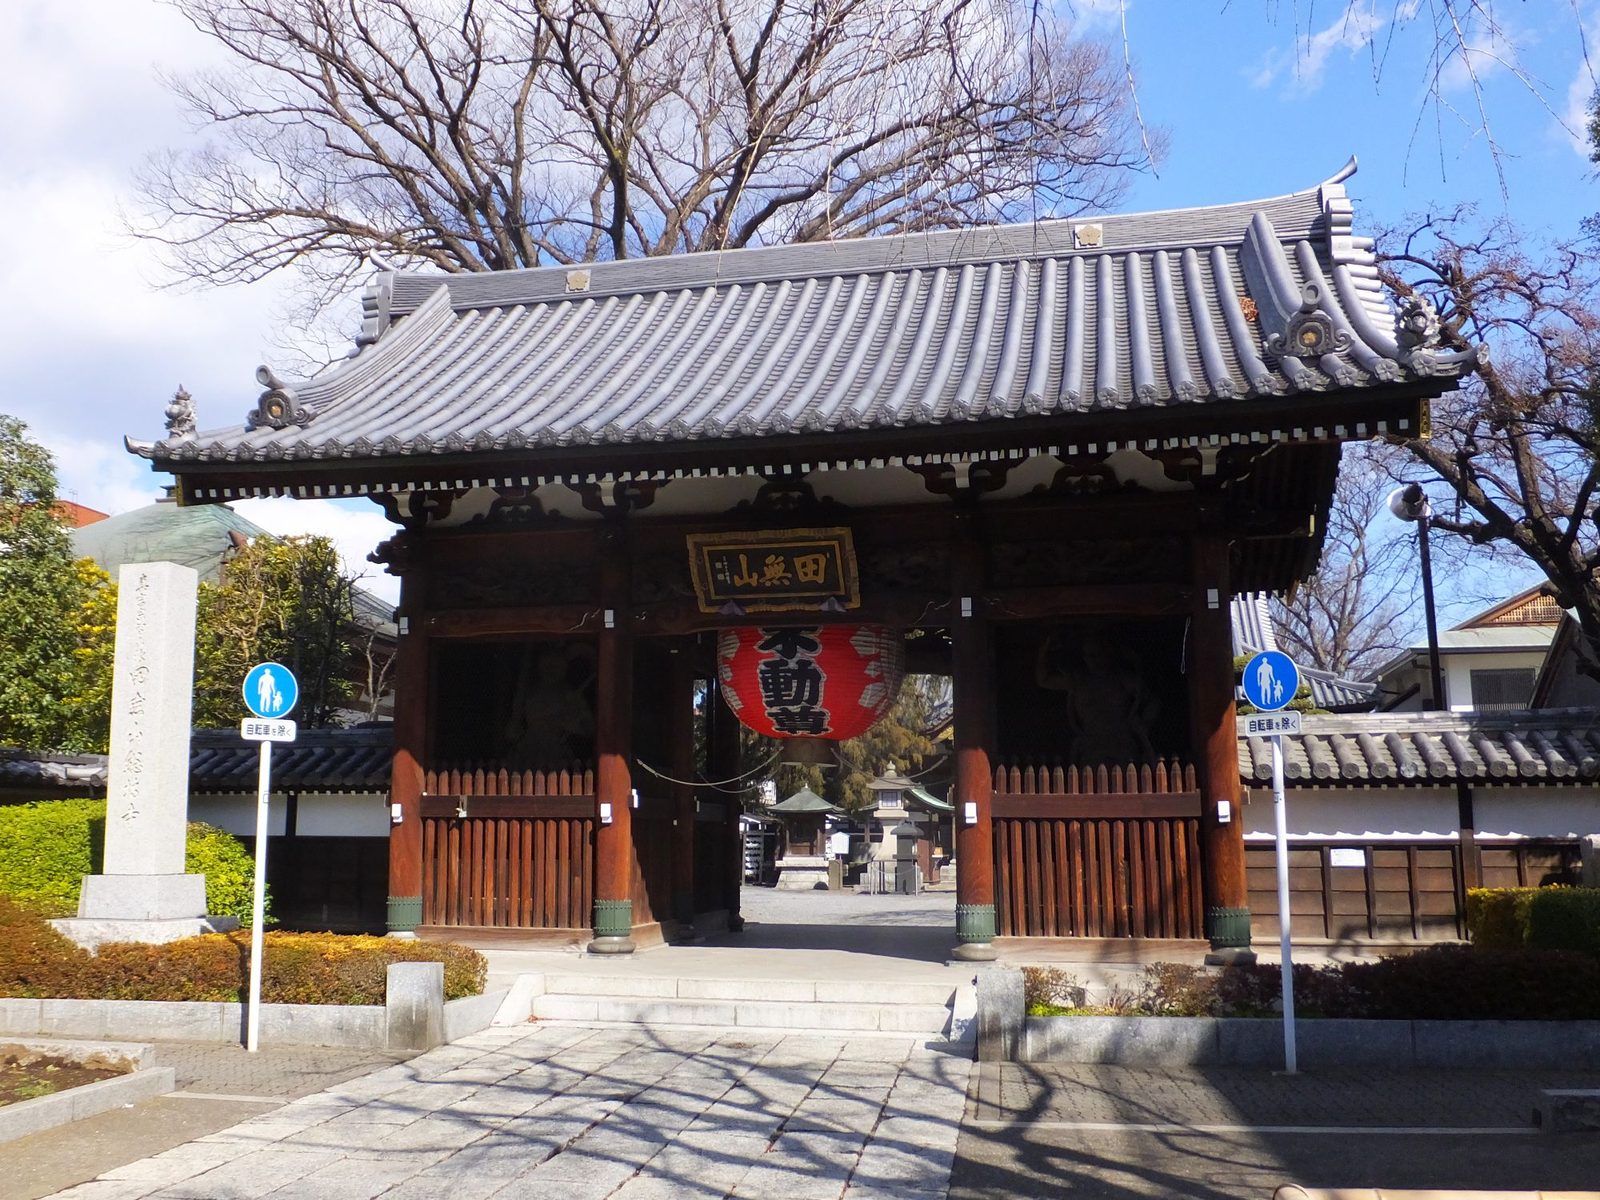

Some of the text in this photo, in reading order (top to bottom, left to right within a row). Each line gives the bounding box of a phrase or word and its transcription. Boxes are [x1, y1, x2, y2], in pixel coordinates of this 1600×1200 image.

[246, 723, 292, 736] 自転車を除く
[1249, 716, 1297, 732] 自転車を除く
